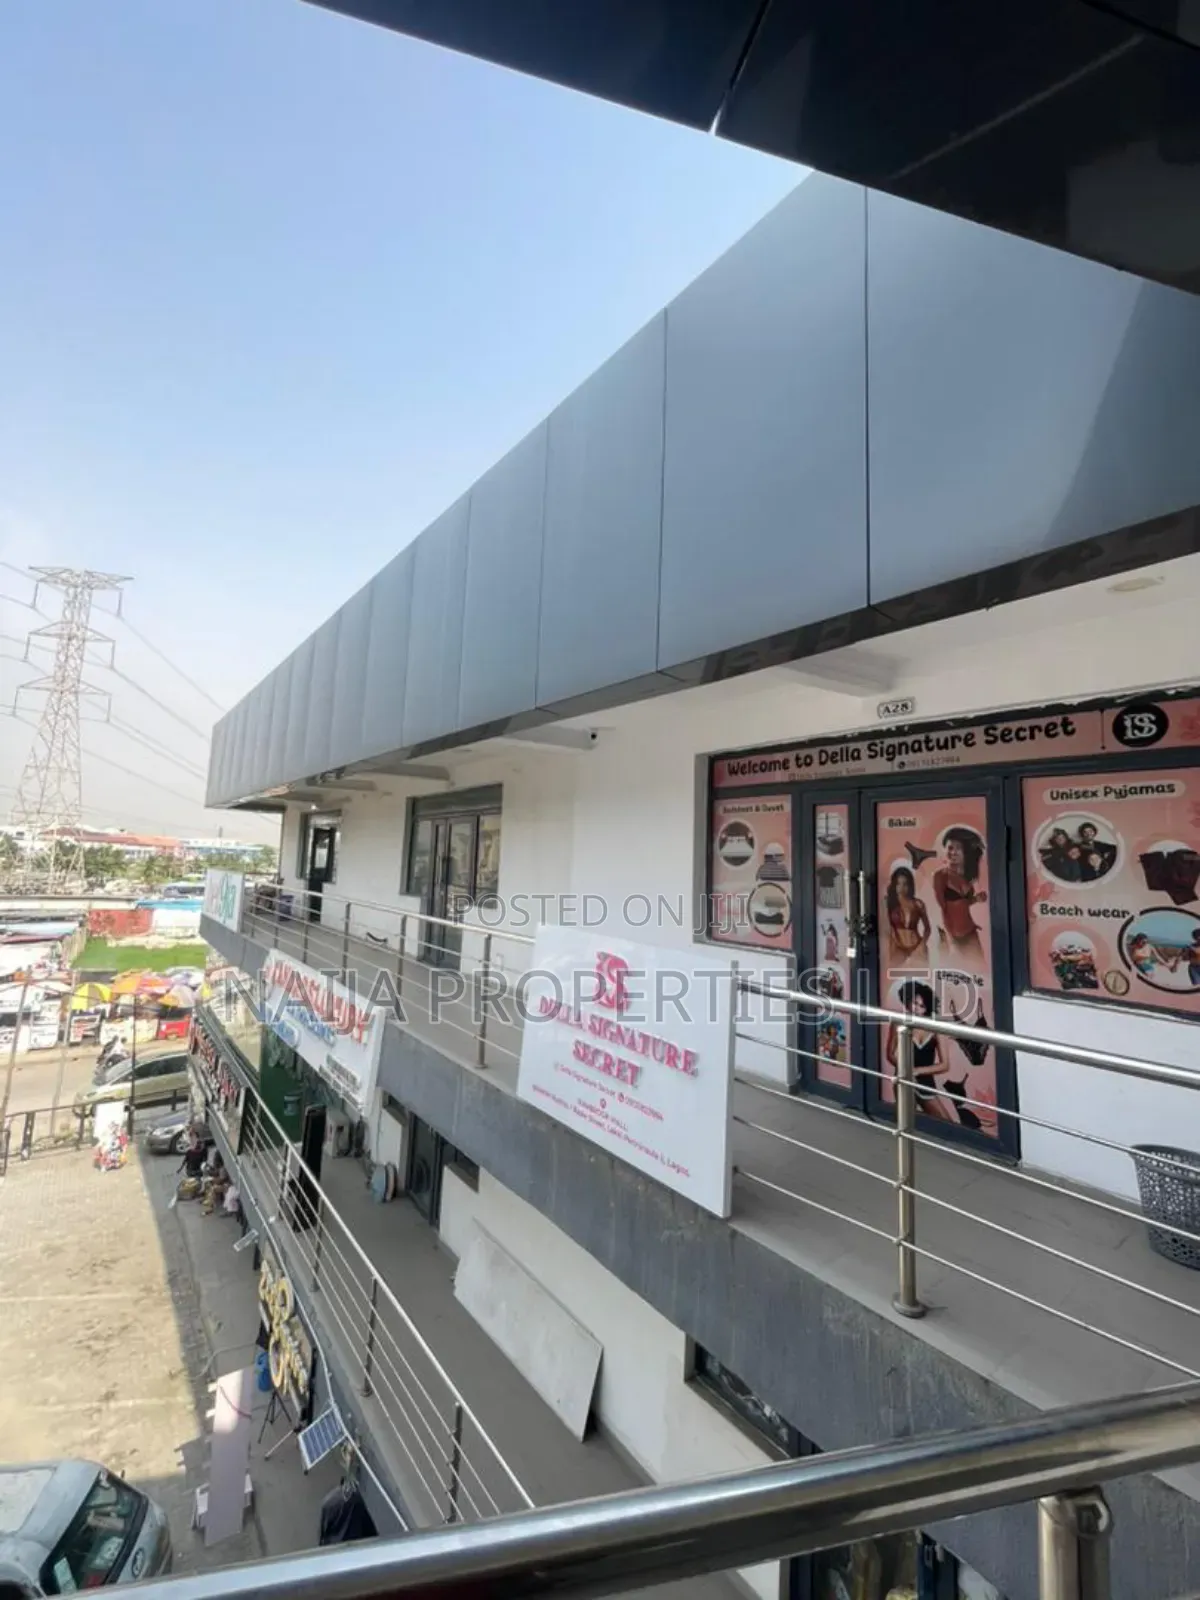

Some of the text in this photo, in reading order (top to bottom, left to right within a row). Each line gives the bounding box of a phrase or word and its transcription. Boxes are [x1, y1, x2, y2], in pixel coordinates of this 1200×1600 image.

[883, 702, 909, 715] A28
[727, 757, 790, 778] Welcome
[795, 755, 813, 769] to
[818, 745, 862, 766] Della
[867, 728, 977, 762] Signature
[984, 715, 1077, 745] Secret
[1050, 782, 1176, 801] Unisex Pyjamas
[888, 818, 916, 828] Bikini
[1040, 903, 1130, 919] Beach wear
[588, 1014, 699, 1078] SIGNATURE
[573, 1039, 642, 1088] SECRET
